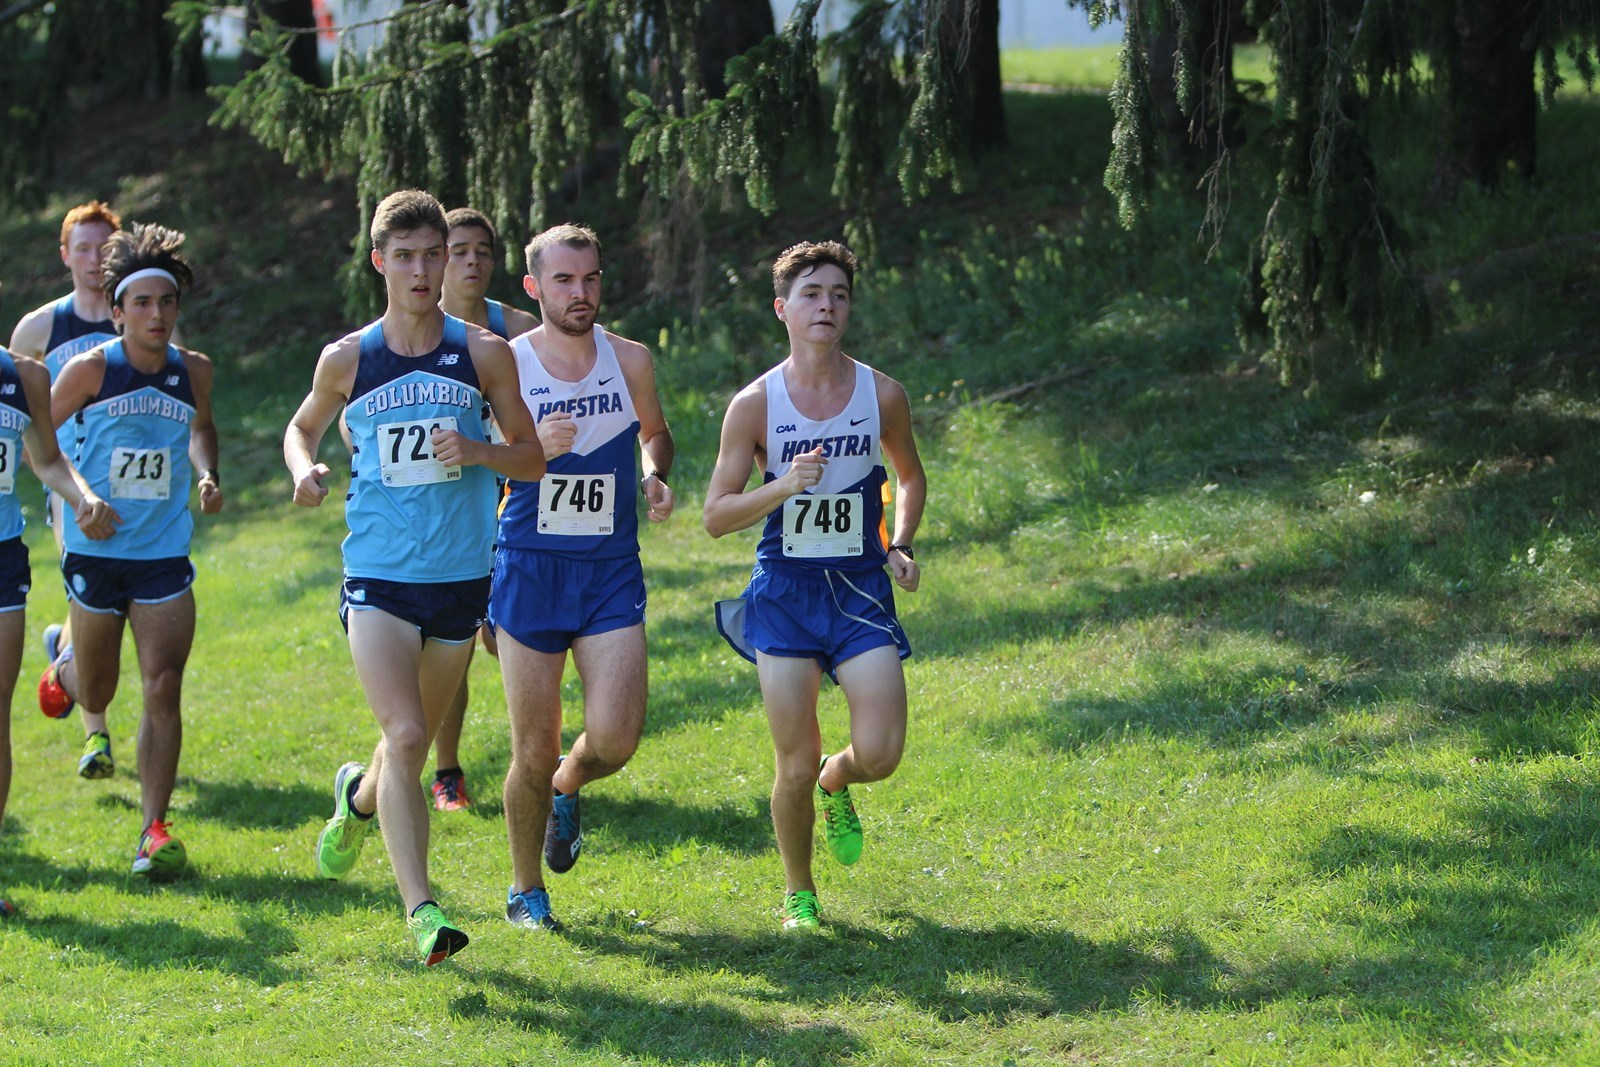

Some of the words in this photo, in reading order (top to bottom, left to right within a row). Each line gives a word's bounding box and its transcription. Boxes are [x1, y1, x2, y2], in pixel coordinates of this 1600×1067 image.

[364, 381, 473, 418] COLUMBIA
[529, 386, 551, 396] CAA
[107, 396, 190, 425] COLUMBIA
[388, 422, 440, 464] 72
[776, 424, 797, 434] CAA
[118, 452, 164, 480] 713
[550, 478, 605, 513] 746
[794, 498, 852, 534] 748
